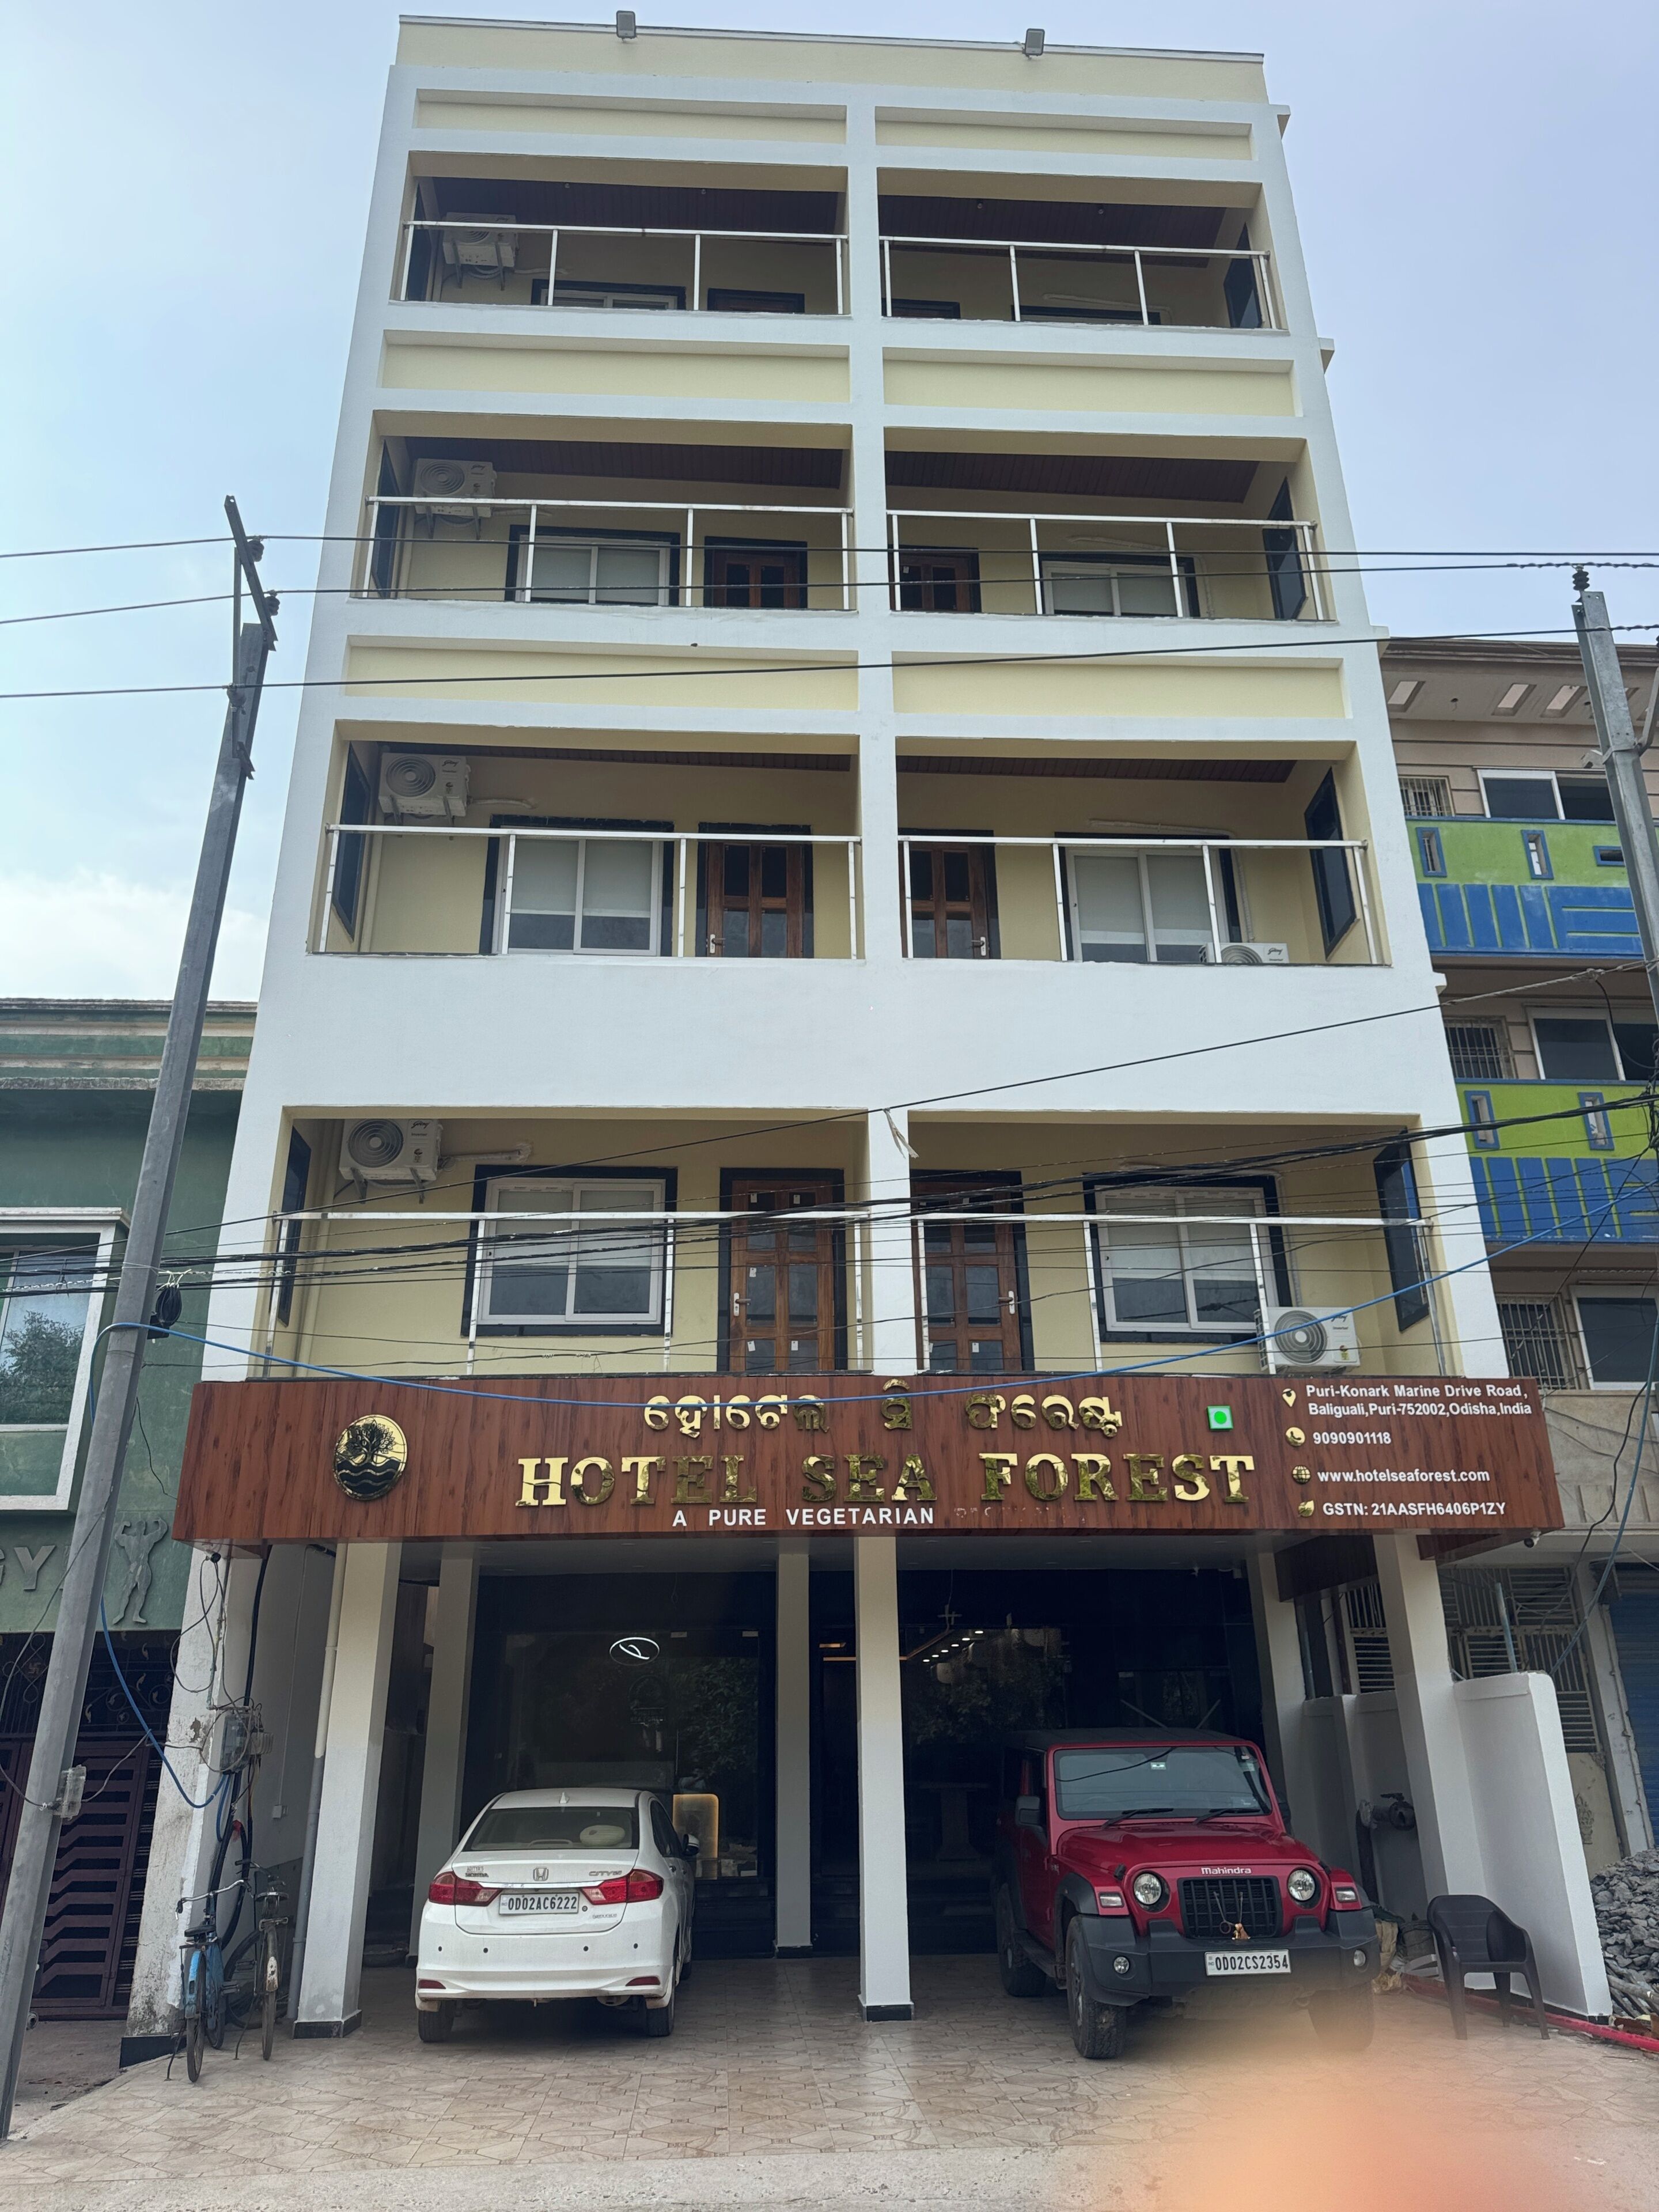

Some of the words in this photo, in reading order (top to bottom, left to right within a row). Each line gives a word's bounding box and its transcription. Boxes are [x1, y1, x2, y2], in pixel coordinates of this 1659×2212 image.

[1306, 1384, 1390, 1397] Puri-Konark
[1394, 1384, 1440, 1397] Marine
[1445, 1384, 1482, 1397] Drive
[644, 1394, 830, 1438] ହୋଟେଲ
[1313, 1431, 1392, 1445] 9090901118
[515, 1455, 757, 1506] HOTEL
[801, 1453, 938, 1502] SEA
[979, 1452, 1255, 1503] FOREST
[1317, 1468, 1490, 1482] www.hotelseaforest.com
[1323, 1502, 1369, 1516] GSTN:
[1371, 1502, 1506, 1516] 21AASFH6406P1ZY
[672, 1509, 687, 1527] A
[709, 1508, 767, 1527] PURE
[786, 1506, 934, 1526] VEGETARIAN
